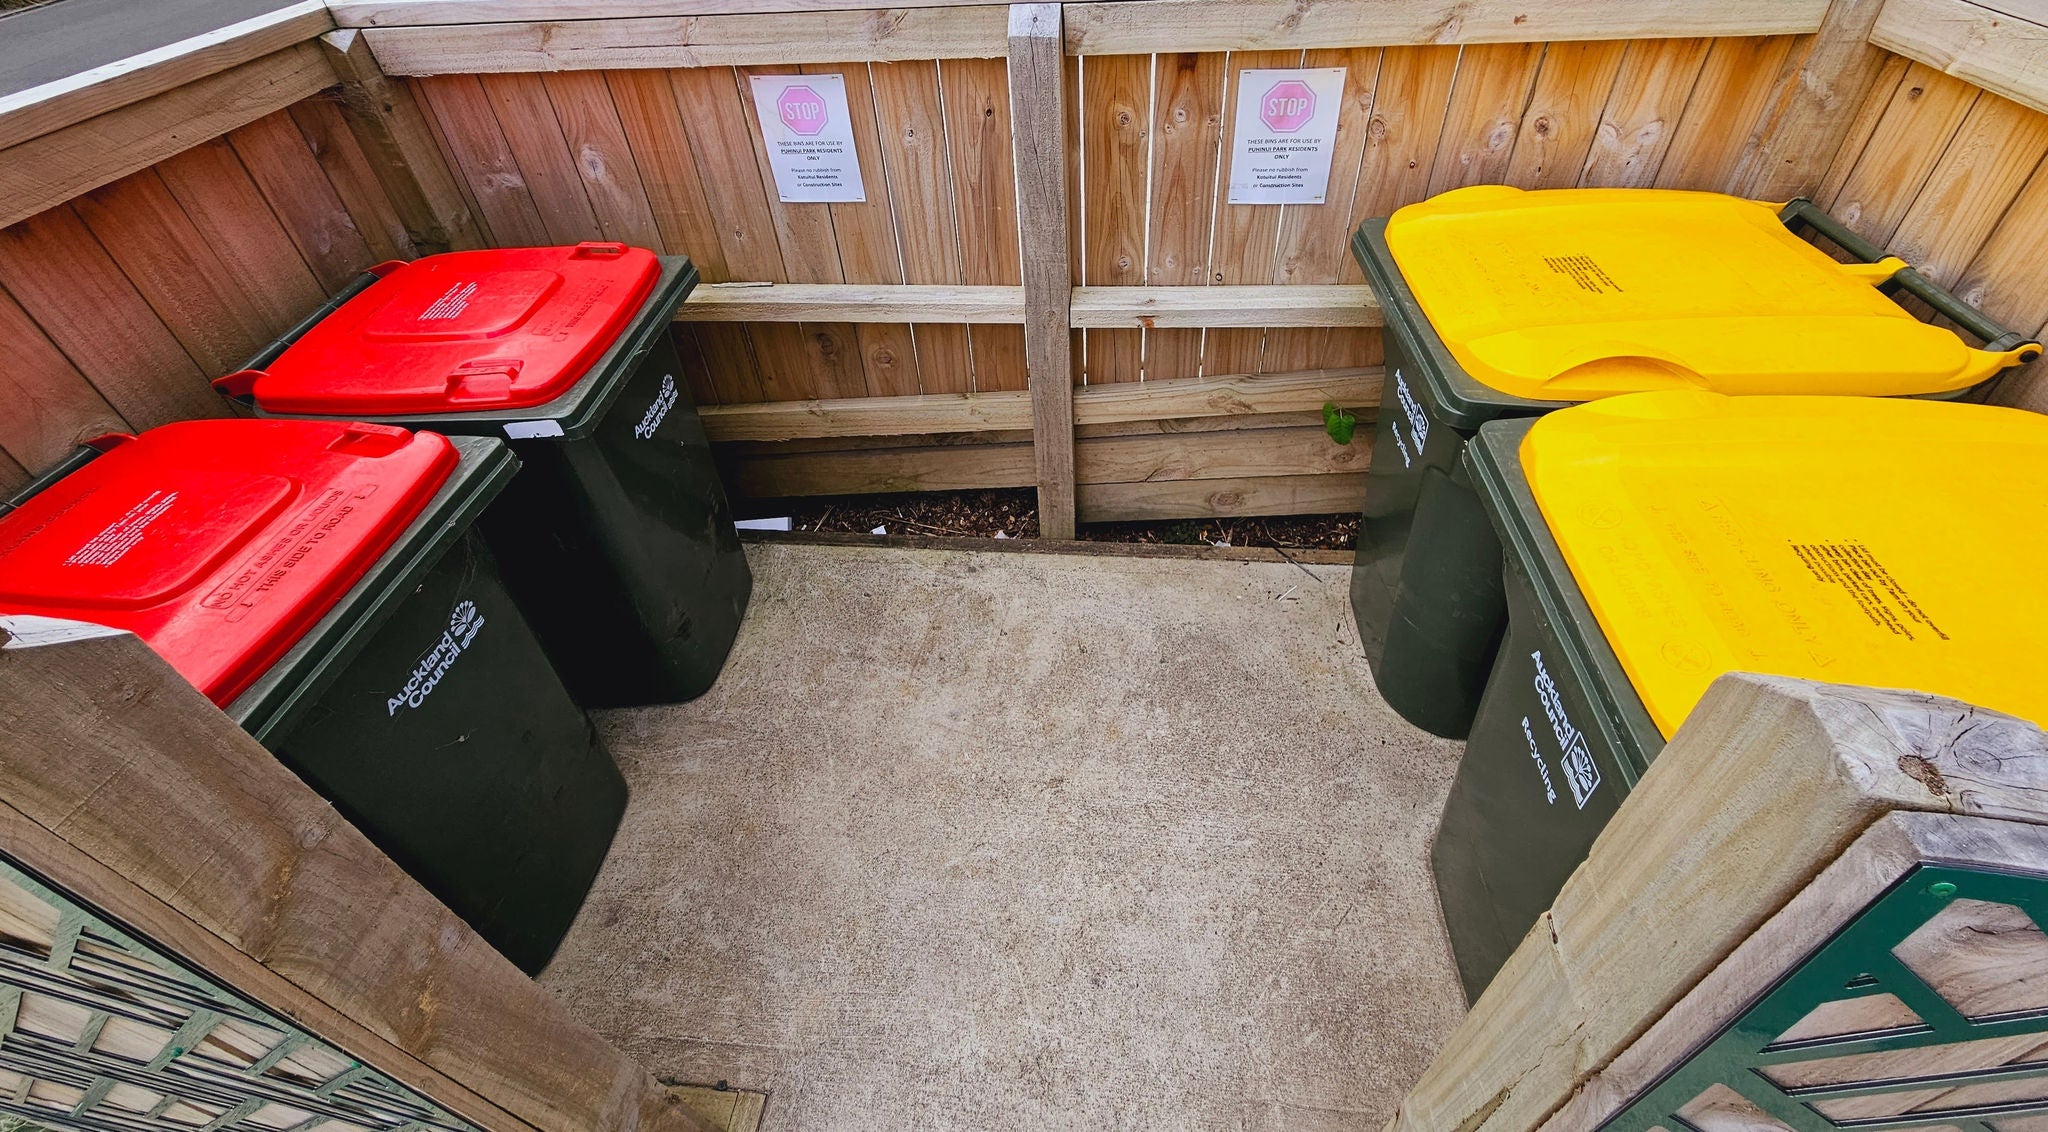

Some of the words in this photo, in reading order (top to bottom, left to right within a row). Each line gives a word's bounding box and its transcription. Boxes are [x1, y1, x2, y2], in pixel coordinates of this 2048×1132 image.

[785, 102, 819, 120] STOP
[1268, 98, 1307, 116] STOP
[634, 390, 664, 439] Auckland
[643, 398, 668, 439] Council
[1395, 368, 1416, 414] Auckland
[1397, 386, 1414, 426] Council
[1392, 420, 1410, 468] Recycling
[214, 591, 232, 607] NO
[230, 569, 256, 592] HOT
[254, 537, 291, 568] ASHES
[290, 523, 308, 537] OR
[306, 490, 344, 522] LIQUIDS
[256, 569, 287, 593] THIS
[283, 546, 312, 568] SIDE
[307, 532, 326, 545] TO
[322, 506, 354, 532] ROAD
[388, 630, 453, 716] Auckland
[408, 641, 462, 708] Council
[1530, 650, 1574, 740] Auckland
[1534, 674, 1570, 752] Council
[1522, 716, 1557, 805] Recycling
